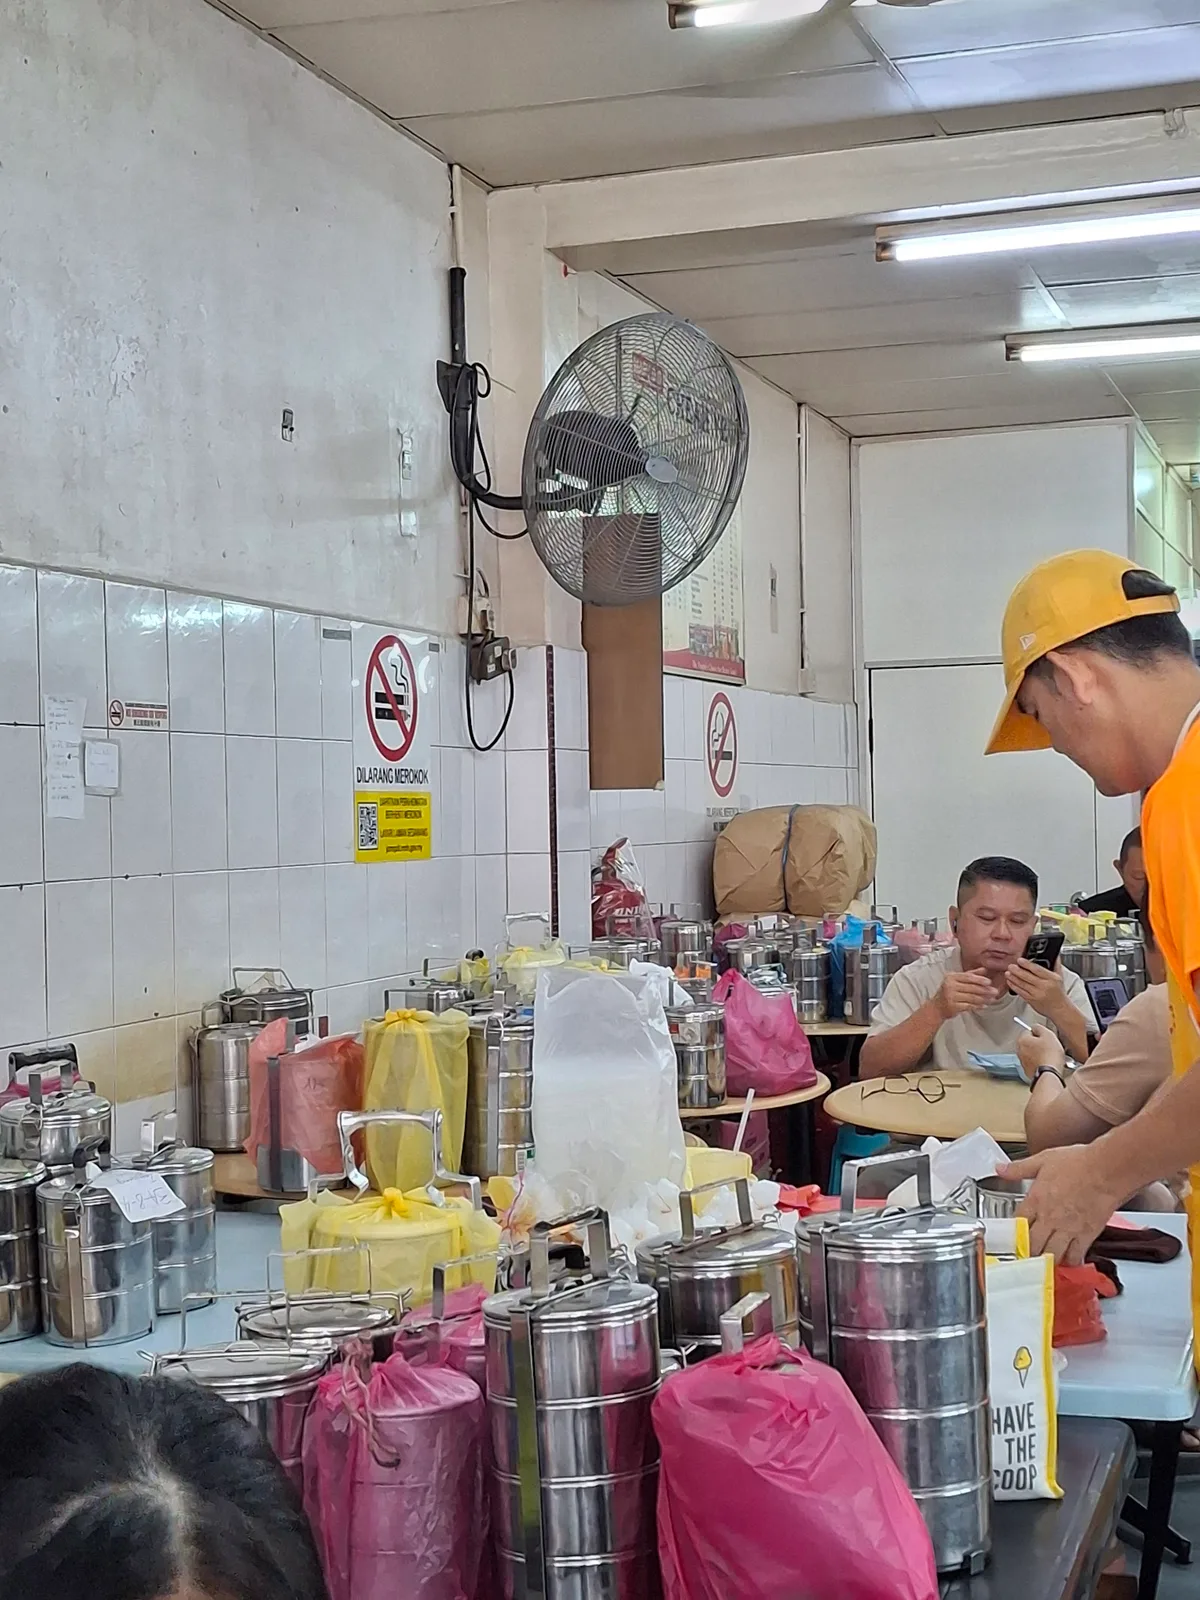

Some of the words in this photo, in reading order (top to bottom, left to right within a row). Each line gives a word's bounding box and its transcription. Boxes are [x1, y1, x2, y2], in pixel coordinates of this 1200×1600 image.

[357, 767, 393, 783] DILARANG
[395, 768, 429, 784] MEROKOK
[992, 1402, 1036, 1436] HAVE
[1005, 1433, 1036, 1465] THE
[993, 1464, 1037, 1490] COOP
